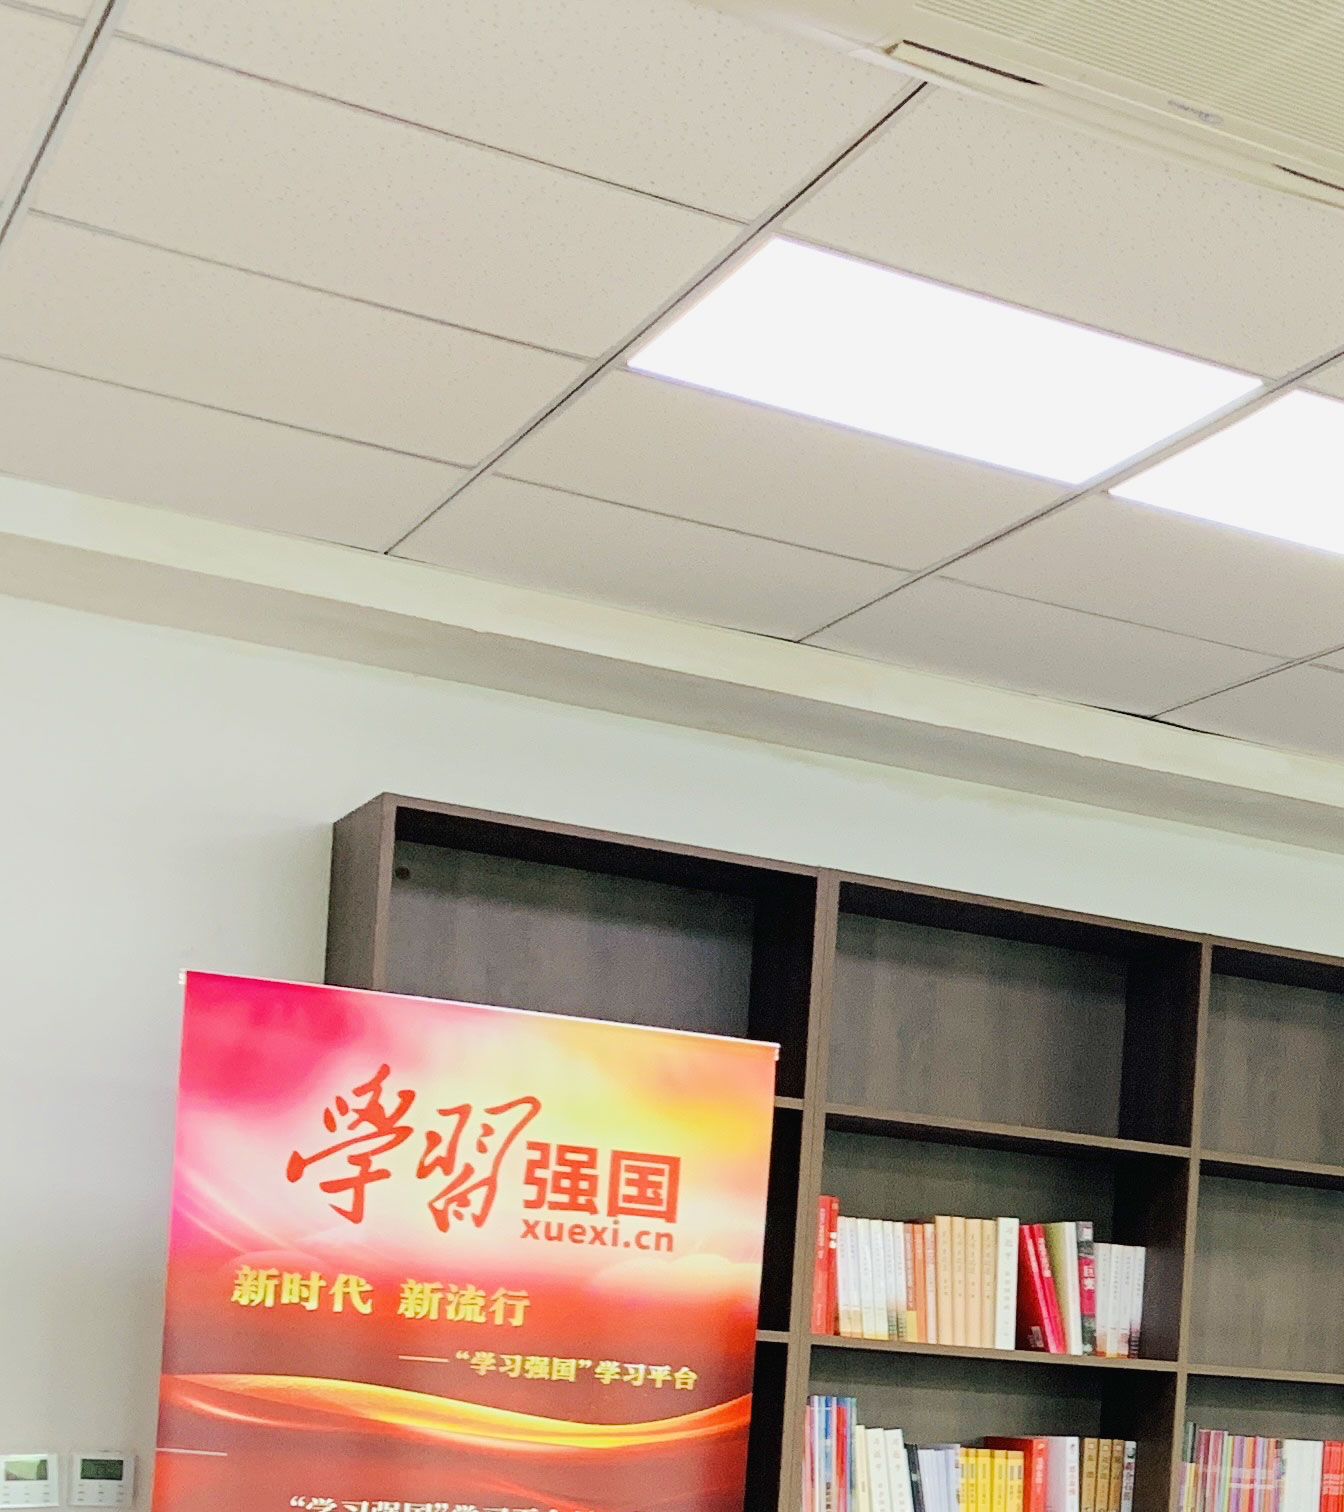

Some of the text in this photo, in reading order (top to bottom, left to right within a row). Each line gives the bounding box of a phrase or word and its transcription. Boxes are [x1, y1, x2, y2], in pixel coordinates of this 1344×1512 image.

[520, 1217, 675, 1253] xuexi.cn
[230, 1264, 531, 1327] 新时代 新流行
